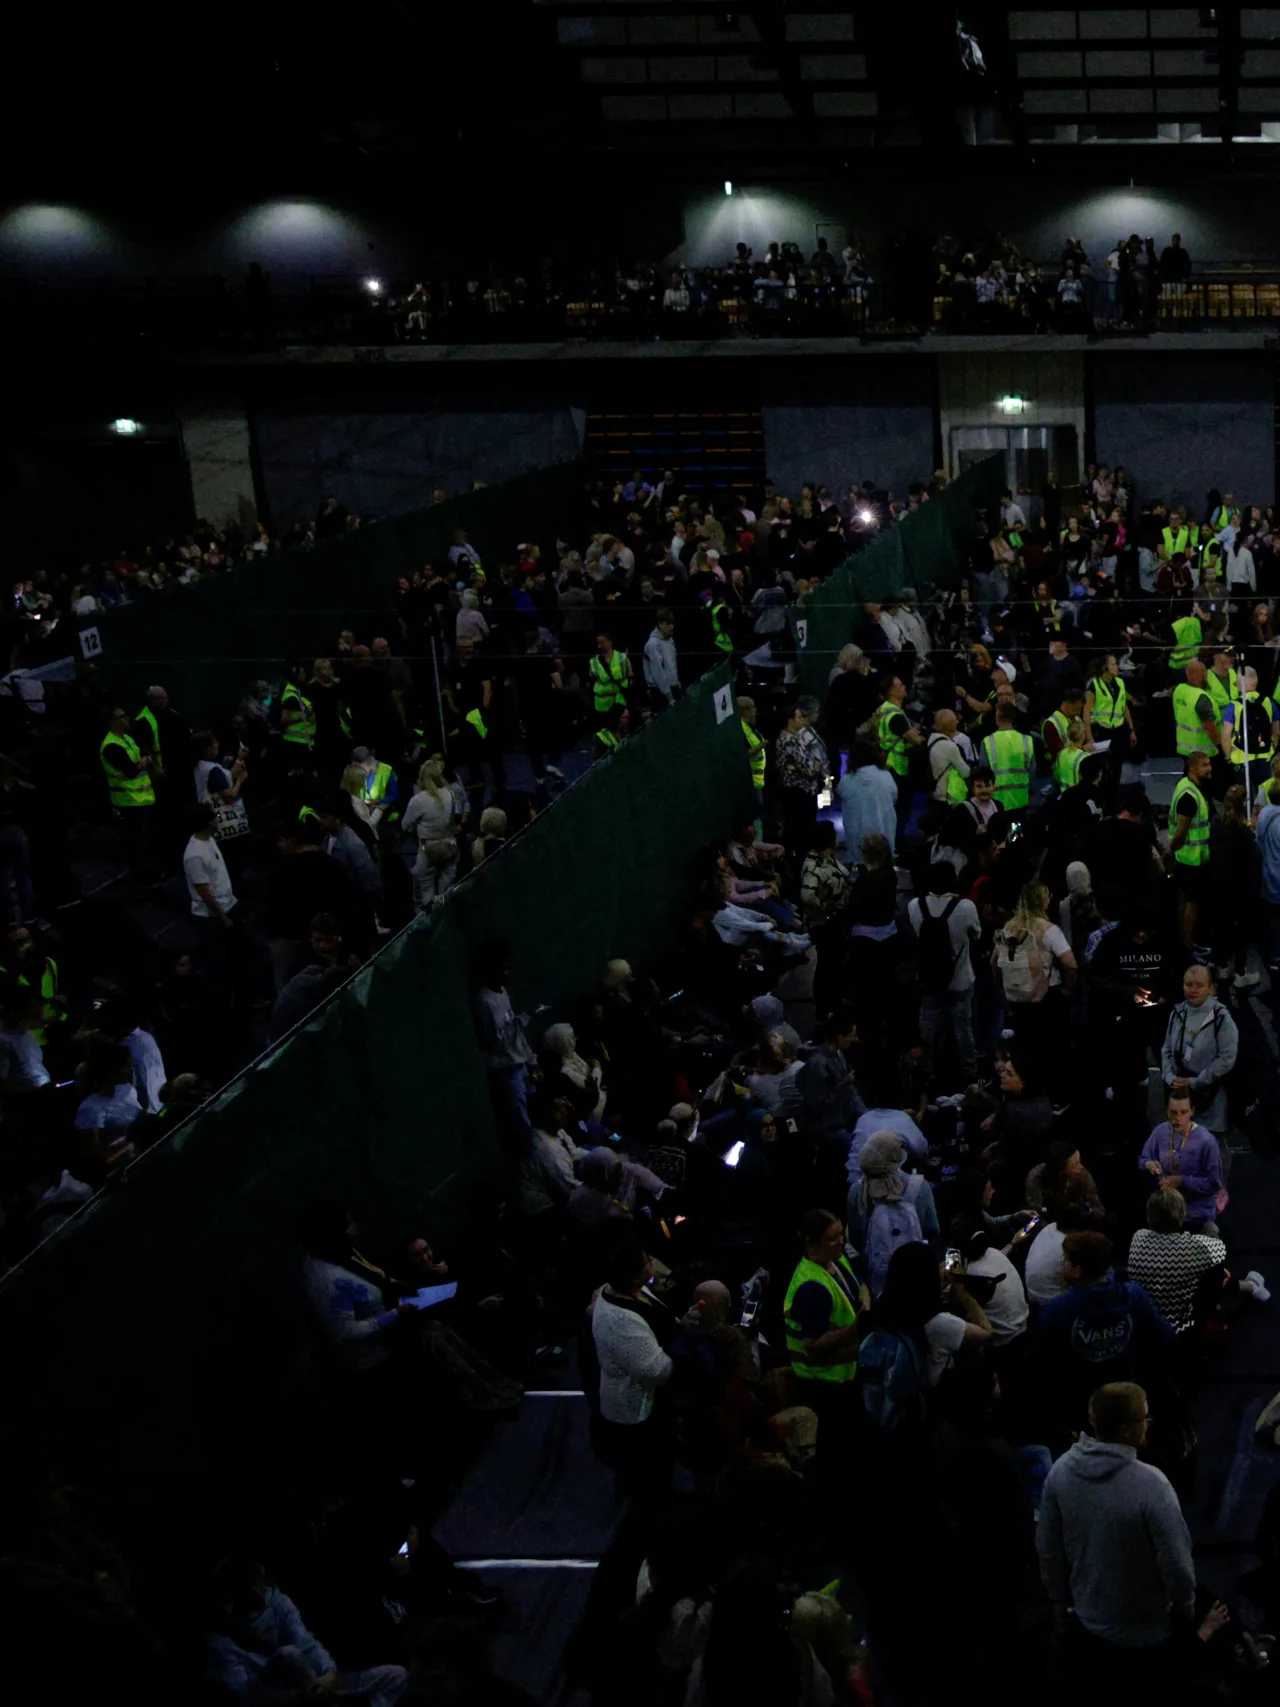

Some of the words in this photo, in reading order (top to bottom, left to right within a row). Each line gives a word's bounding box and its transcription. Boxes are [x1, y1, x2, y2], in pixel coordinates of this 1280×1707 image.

[85, 633, 98, 651] 12
[1119, 953, 1162, 964] MILANO
[1077, 1320, 1126, 1346] VANS
